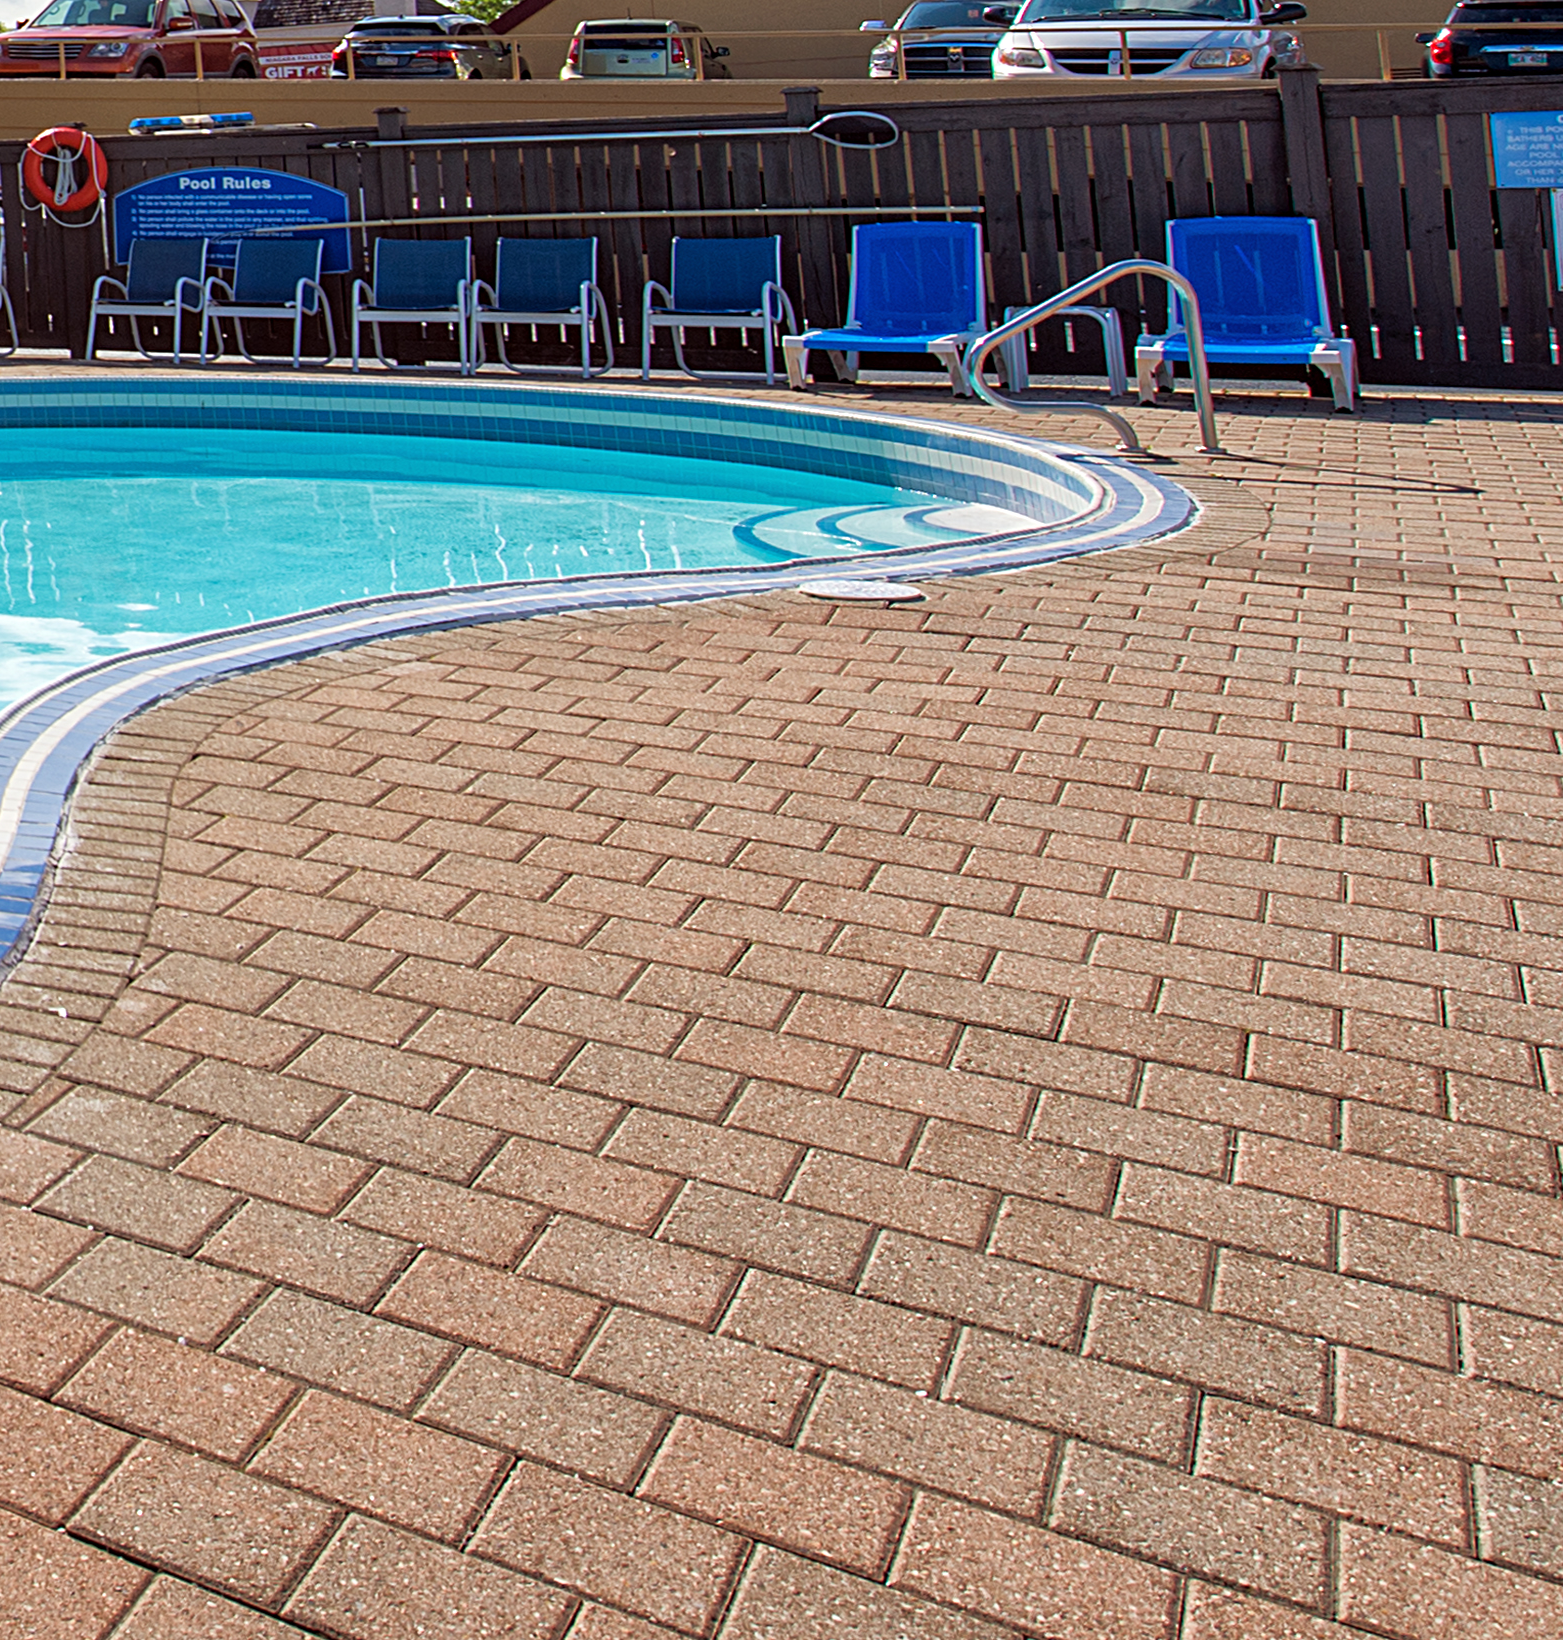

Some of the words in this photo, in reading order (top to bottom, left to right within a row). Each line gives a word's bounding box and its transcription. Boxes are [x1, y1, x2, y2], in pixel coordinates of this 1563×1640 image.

[265, 66, 305, 79] GIFT
[1529, 151, 1561, 159] POOL
[179, 176, 216, 190] Pool
[222, 176, 272, 190] Rules
